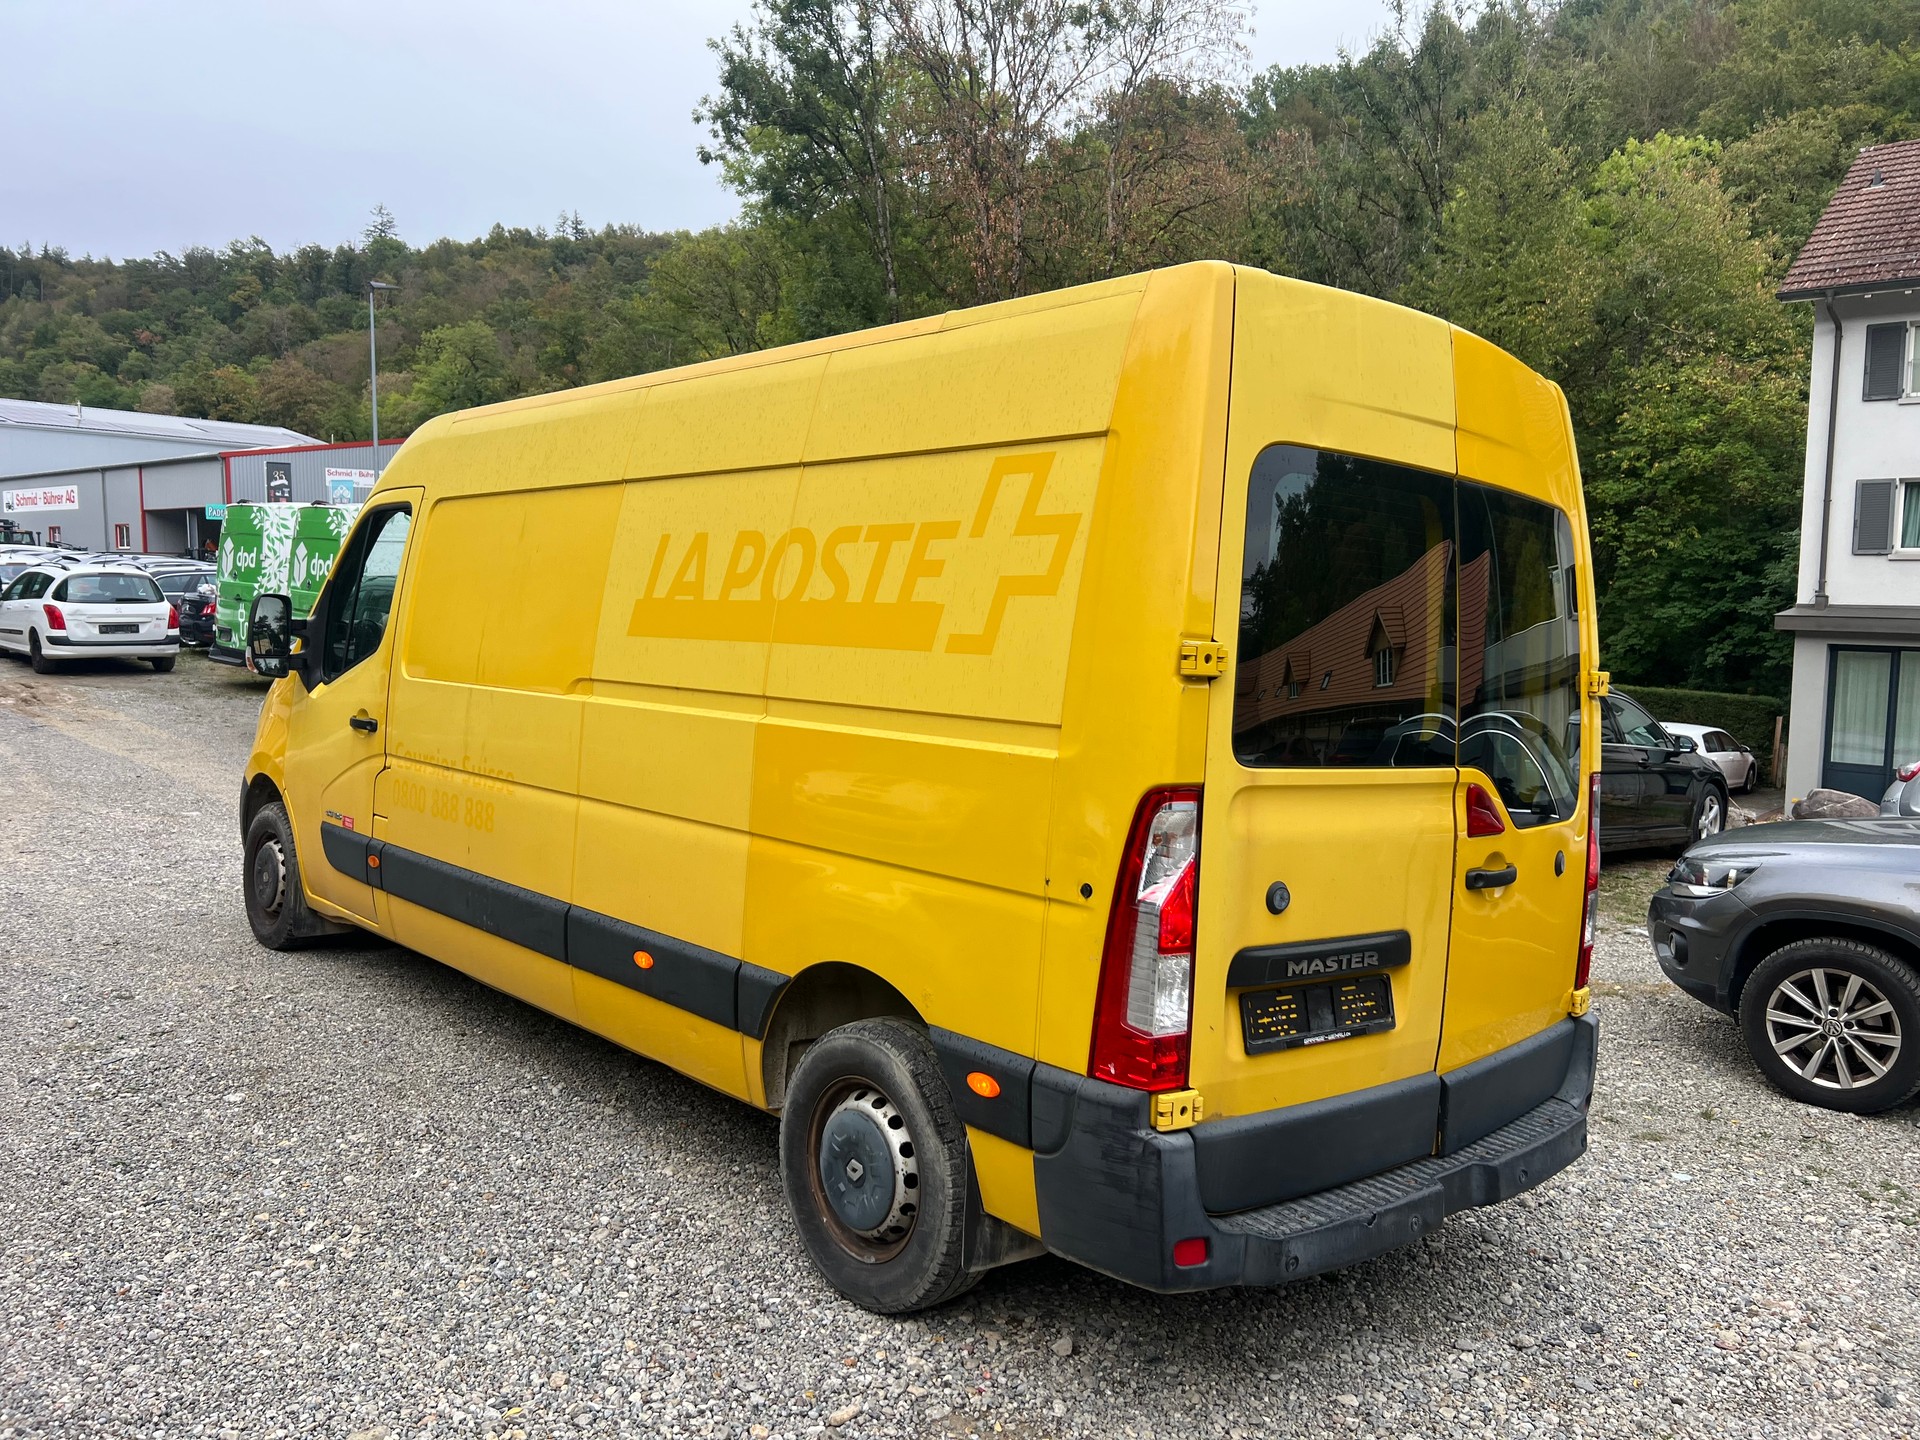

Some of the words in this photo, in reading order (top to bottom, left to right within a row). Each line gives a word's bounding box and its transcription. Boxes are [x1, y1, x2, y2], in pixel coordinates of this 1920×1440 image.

[327, 469, 353, 478] Schmid
[358, 470, 374, 478] Bühr
[15, 492, 38, 507] Schmid
[43, 490, 63, 505] Bührer
[65, 489, 75, 504] AG
[236, 545, 257, 572] dpd
[310, 552, 334, 581] dpd
[648, 532, 709, 602] LA
[718, 520, 961, 604] POSTE
[462, 755, 515, 795] Suisse
[393, 779, 426, 814] 0800
[431, 789, 459, 823] 888
[464, 797, 495, 833] 888
[1287, 951, 1379, 976] MASTER
